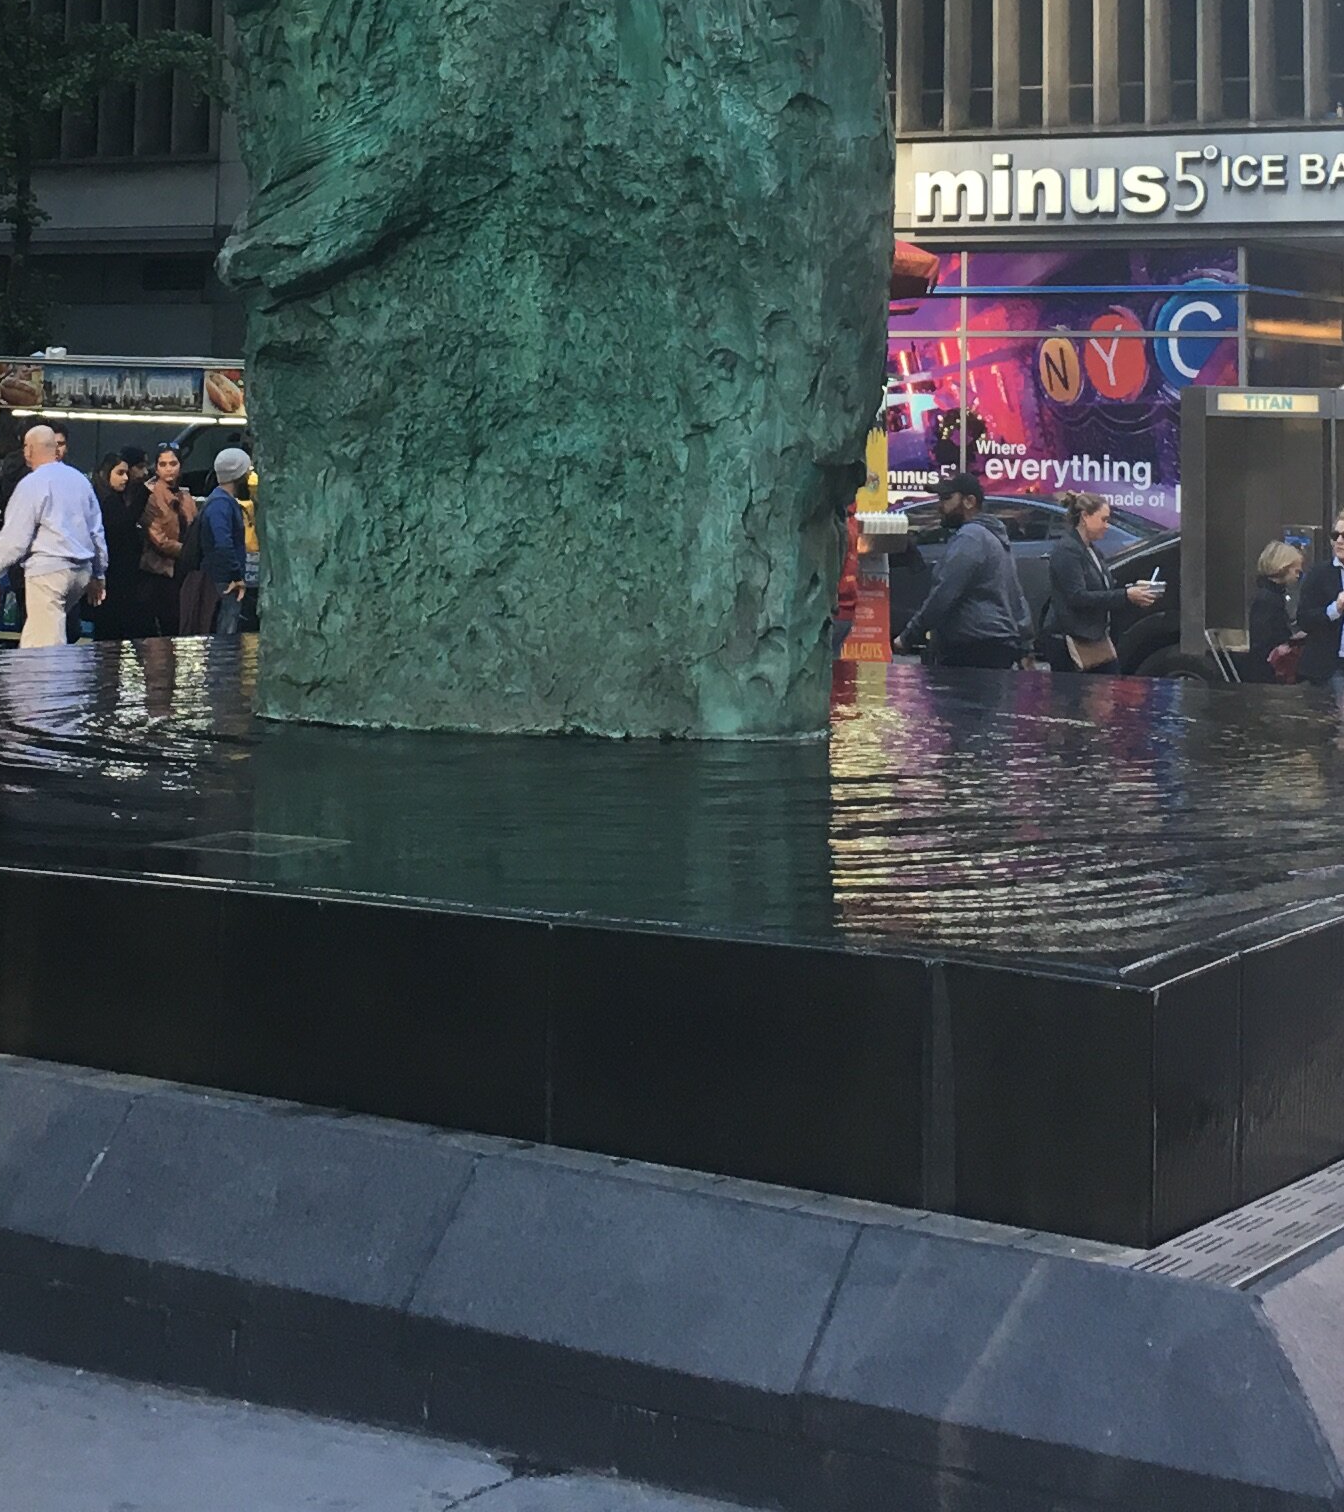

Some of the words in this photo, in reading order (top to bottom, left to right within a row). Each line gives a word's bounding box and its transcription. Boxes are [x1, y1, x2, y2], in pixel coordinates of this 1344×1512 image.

[914, 153, 1168, 221] minus
[1220, 154, 1287, 188] ICE
[1044, 300, 1223, 392] NYC
[53, 372, 85, 395] THE
[89, 375, 143, 399] HALAL
[148, 378, 195, 399] GUYS
[1243, 395, 1293, 410] TITAN
[976, 440, 1027, 456] Where
[984, 454, 1152, 488] everything
[1148, 492, 1166, 507] of
